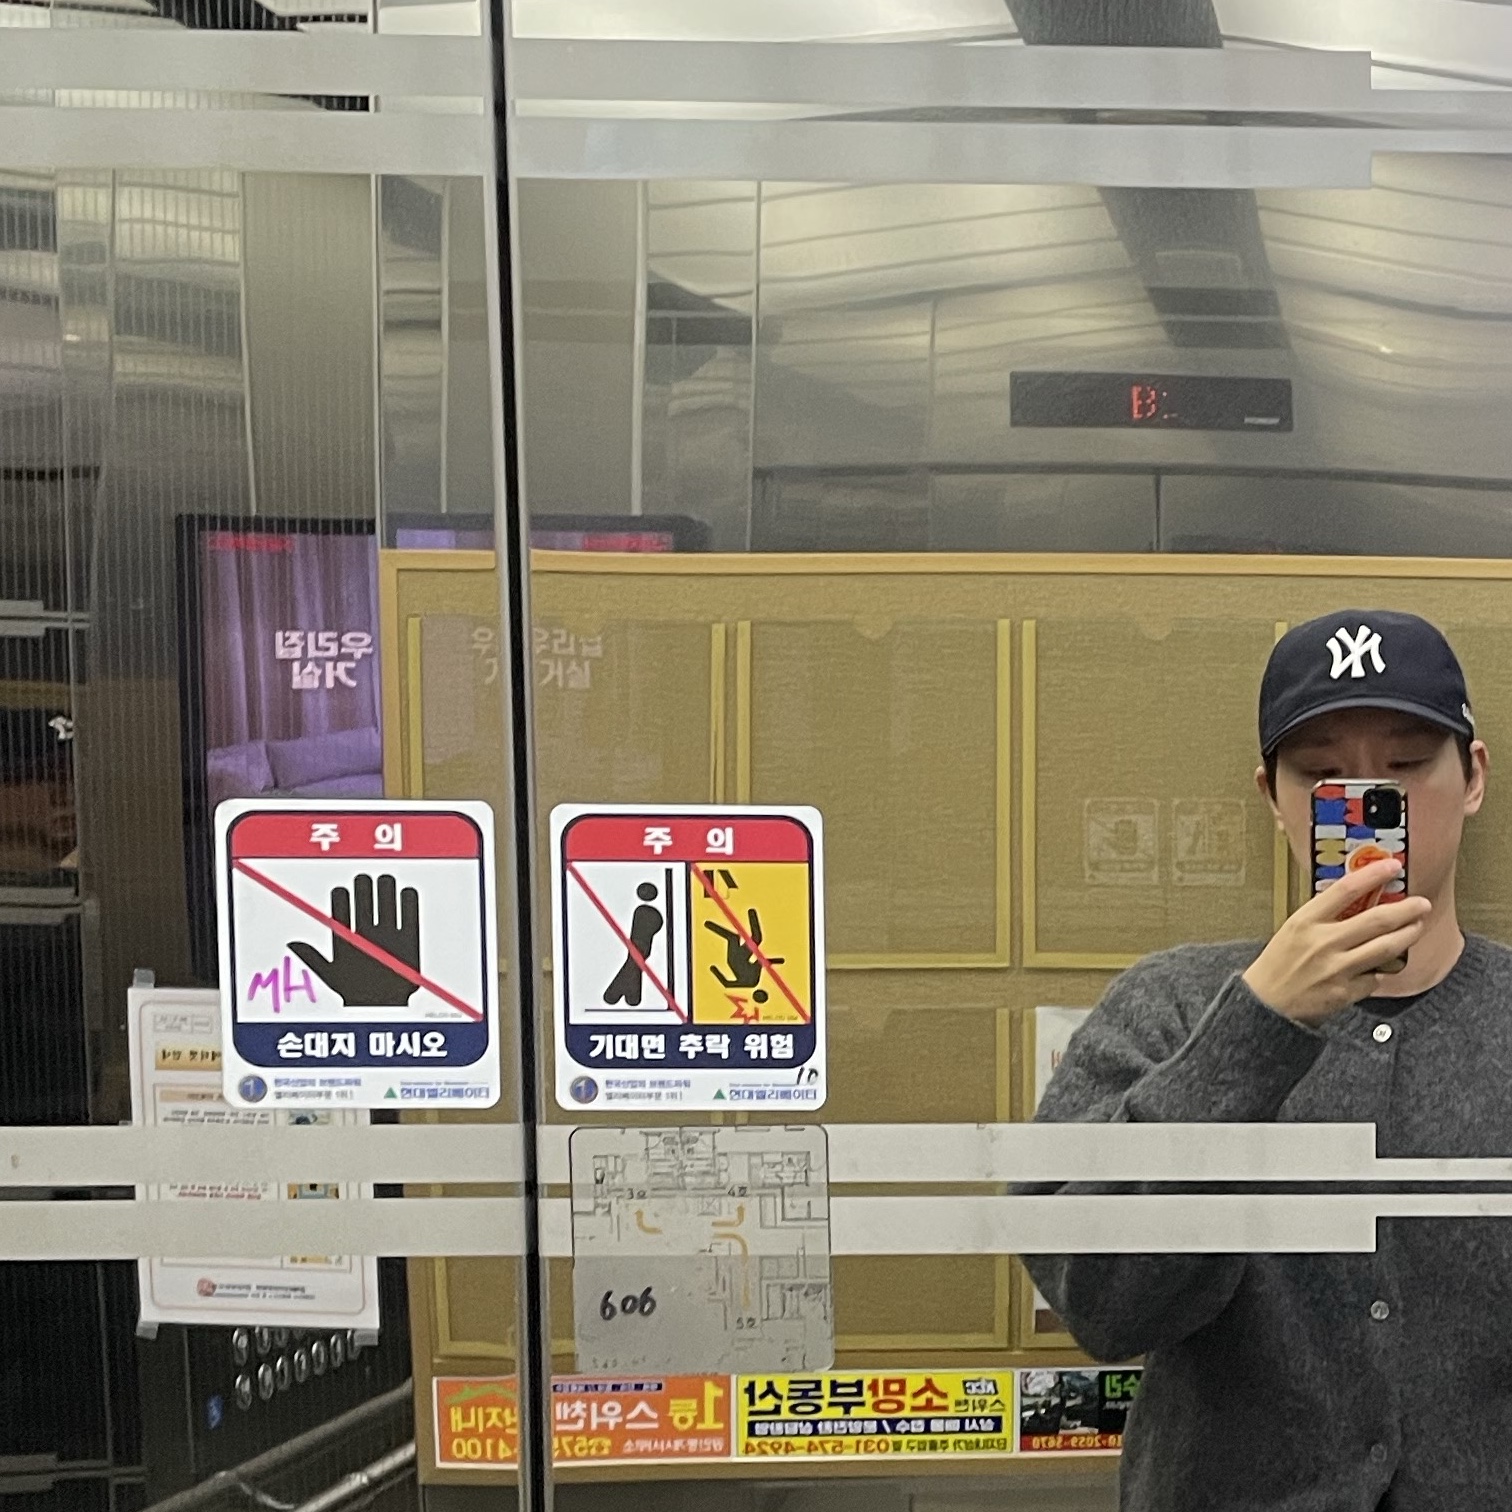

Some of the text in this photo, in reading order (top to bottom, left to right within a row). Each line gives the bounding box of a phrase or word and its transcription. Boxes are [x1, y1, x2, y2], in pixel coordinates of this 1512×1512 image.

[1326, 624, 1386, 680] NY
[248, 956, 316, 1013] MH
[277, 1031, 448, 1057] 손대지 마시오
[589, 1034, 794, 1059] 기대면 추락 위험
[729, 1089, 817, 1101] 현대엘리베이터
[600, 1286, 657, 1321] 606
